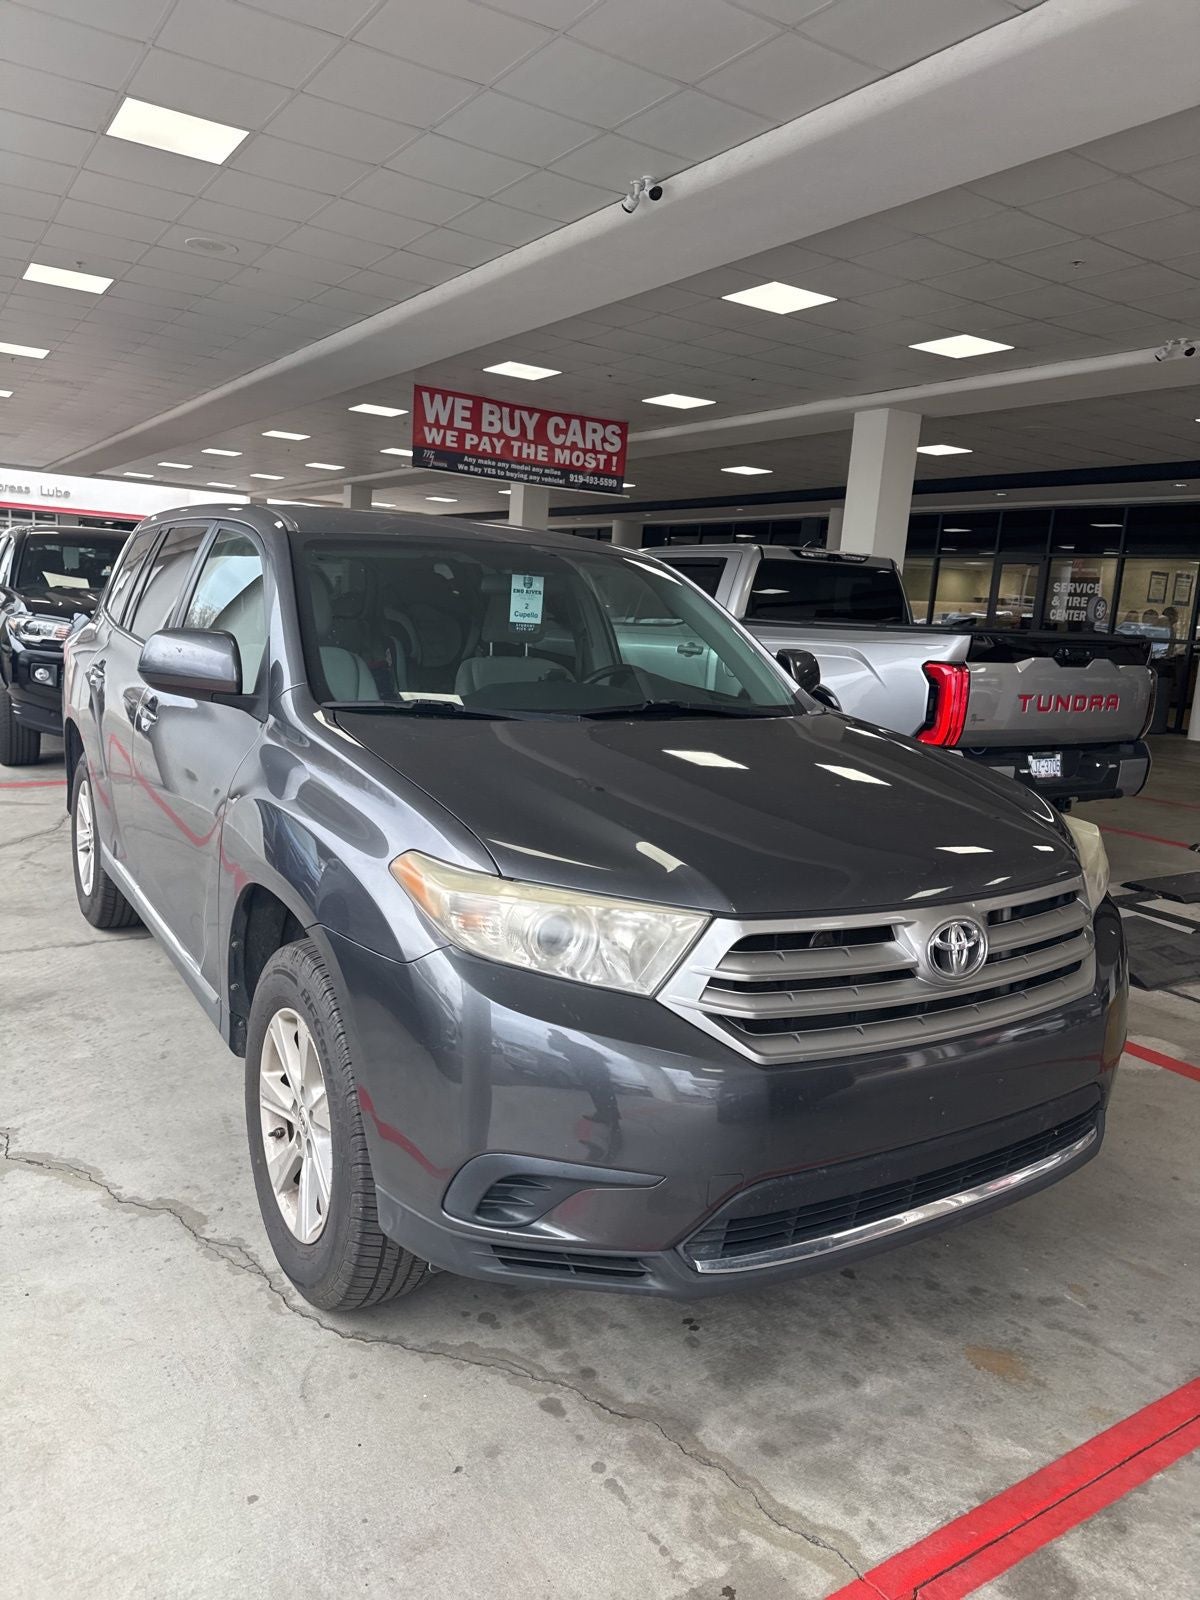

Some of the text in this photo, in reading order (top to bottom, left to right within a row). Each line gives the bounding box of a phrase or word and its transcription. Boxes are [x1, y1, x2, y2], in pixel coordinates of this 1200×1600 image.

[421, 391, 622, 453] WE BUY CARS
[423, 426, 458, 448] WE
[465, 433, 505, 454] PAY
[511, 441, 548, 462] THE
[457, 463, 469, 471] We
[469, 465, 482, 474] Say
[483, 467, 496, 475] YES
[505, 470, 528, 480] buying
[529, 473, 540, 482] any
[541, 475, 566, 485] vehicle!
[463, 456, 561, 476] Any make any model any miles
[569, 473, 618, 487] 919-493-5599
[40, 485, 71, 499] Lube
[1053, 582, 1101, 594] SERVICE
[1051, 596, 1088, 607] & TIRE
[1050, 609, 1087, 622] CENTER
[1018, 693, 1120, 713] TUNDRA
